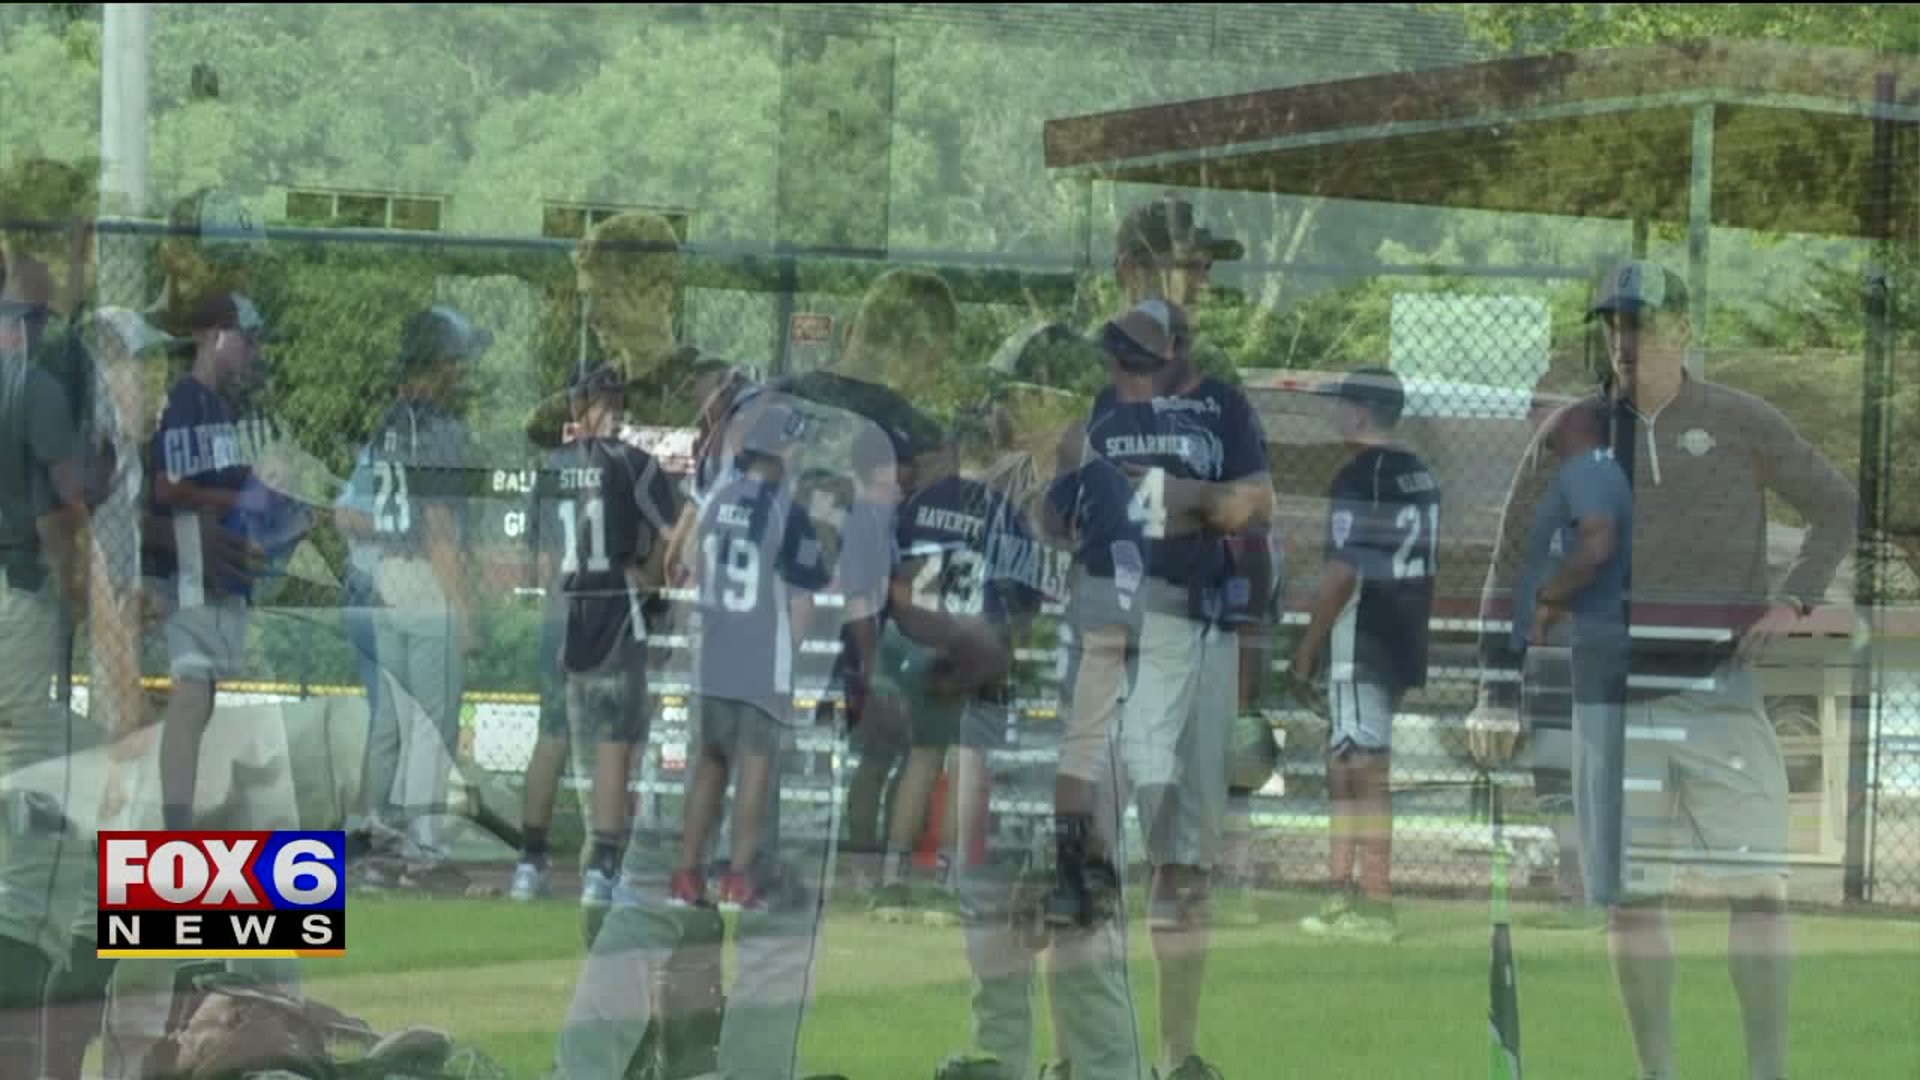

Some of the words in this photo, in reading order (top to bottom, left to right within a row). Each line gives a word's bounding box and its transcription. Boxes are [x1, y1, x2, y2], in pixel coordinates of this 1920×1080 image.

[558, 499, 611, 574] 11
[1127, 466, 1166, 539] 4
[702, 533, 760, 612] 19
[1392, 503, 1439, 578] 21
